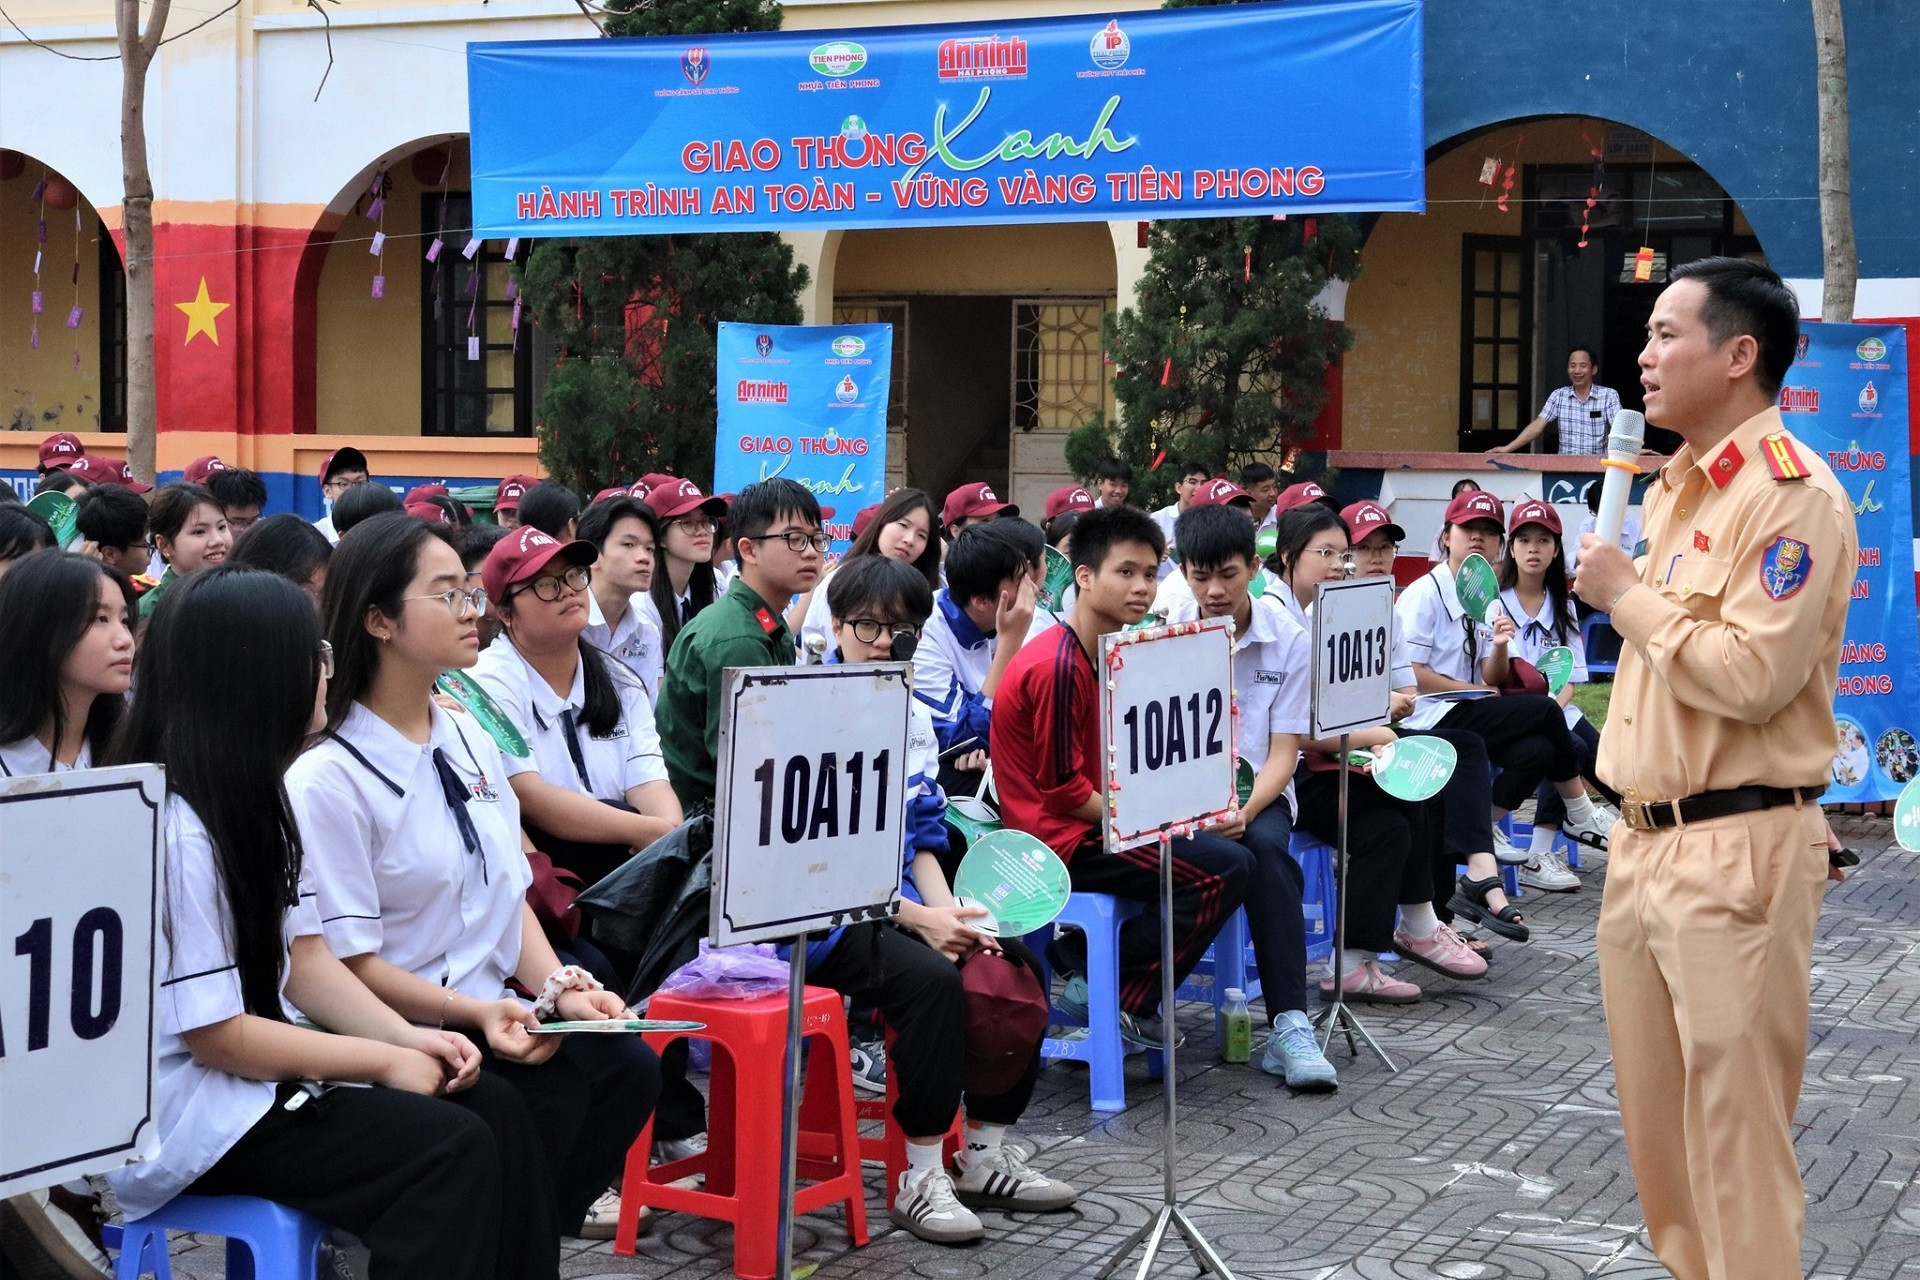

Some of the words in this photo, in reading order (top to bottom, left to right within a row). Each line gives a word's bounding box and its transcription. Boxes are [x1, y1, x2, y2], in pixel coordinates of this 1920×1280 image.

[849, 79, 880, 88] PHONG
[682, 138, 781, 173] GIAO
[898, 86, 1137, 188] Xanh
[517, 186, 600, 219] HÀNH
[610, 182, 700, 216] TRÌNH
[710, 186, 754, 214] AN
[764, 178, 855, 214] TOÀN
[891, 173, 989, 208] VỮNG
[998, 169, 1097, 205] VÀNG
[1106, 165, 1182, 201] TIÊN
[1194, 166, 1326, 199] PHONG
[739, 436, 793, 454] GIAO
[1327, 626, 1386, 684] 10A13
[1836, 674, 1893, 696] HONG
[1124, 688, 1222, 775] 10A12
[754, 749, 889, 846] 10A11
[0, 906, 124, 1058] 10
